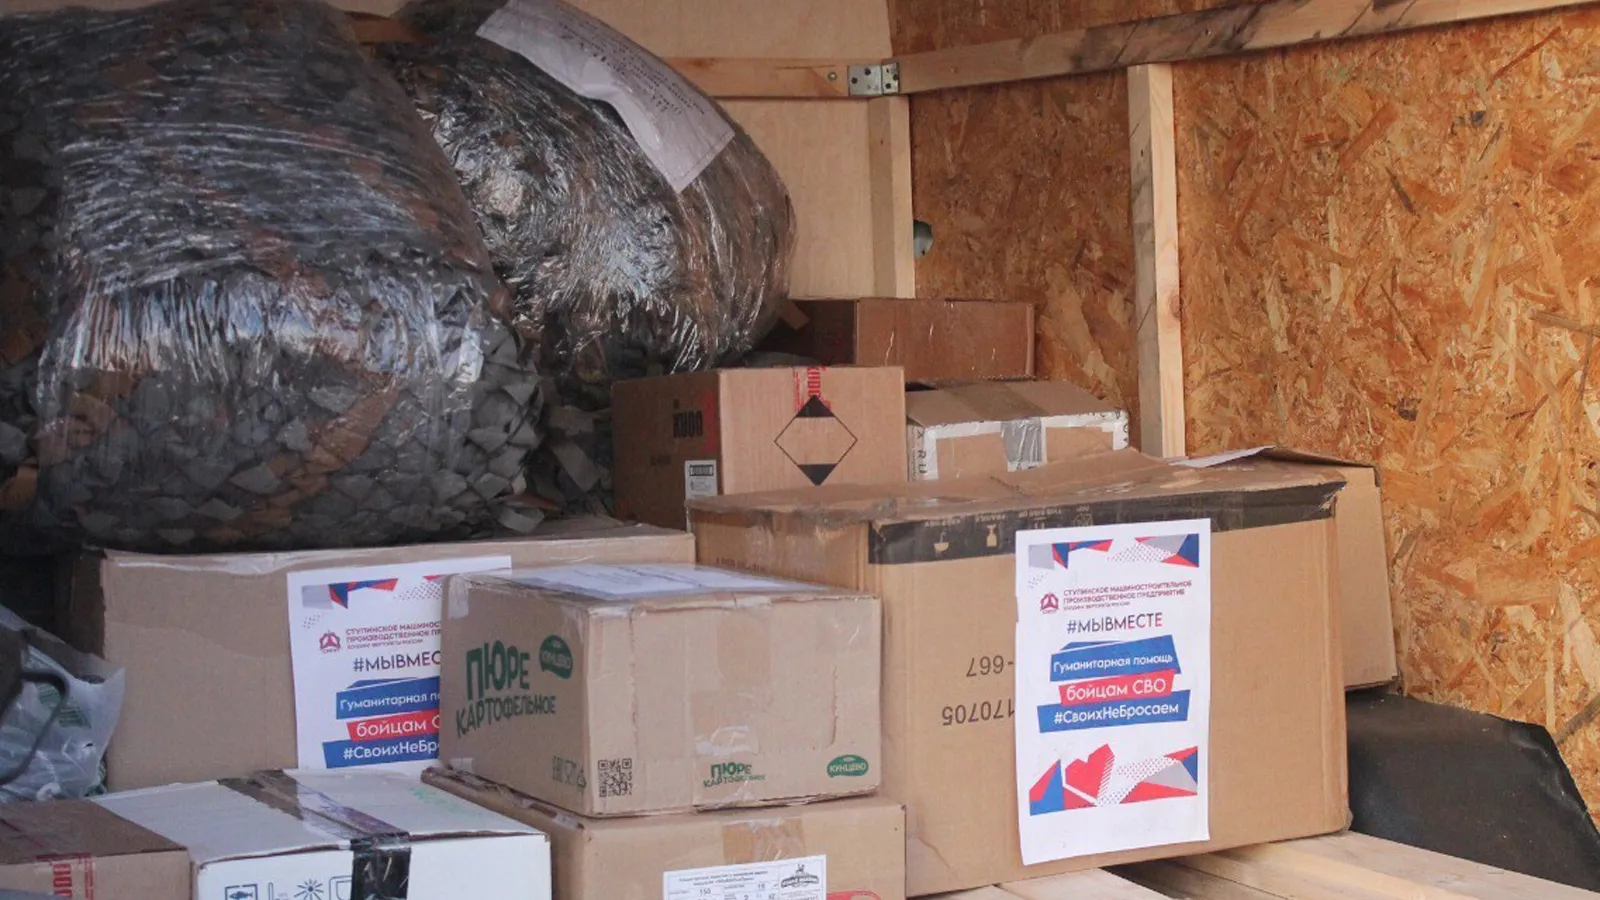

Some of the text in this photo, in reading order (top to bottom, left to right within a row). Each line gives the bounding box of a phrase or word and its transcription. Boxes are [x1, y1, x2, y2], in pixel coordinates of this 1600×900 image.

[1063, 586, 1110, 597] СТУПИНСКОЕ
[1063, 588, 1185, 604] ПРОИЗВОДСТВЕННОЕ ПРЕДПРИЯТИЕ
[345, 621, 441, 635] СТУПИНСКОЕ МАШИНОС
[1066, 612, 1163, 634] #МЫВМЕСТЕ
[346, 630, 430, 643] ПРОИЗВОДСТВЕННОЕ
[353, 650, 442, 672] #МЫВМЕС
[466, 640, 531, 702] ПЮРЕ
[1053, 653, 1174, 674] Гуманитарная помощь
[1066, 678, 1166, 701] бойцам СВО
[340, 693, 428, 711] Гуманитарная
[456, 695, 557, 739] КАРТОФЕЛЬНОЕ
[1054, 702, 1180, 724] #СвоихНеБросаем
[356, 719, 427, 737] бойцам
[343, 739, 441, 760] #СвоихНеБр
[710, 761, 752, 778] ПЮРЕ
